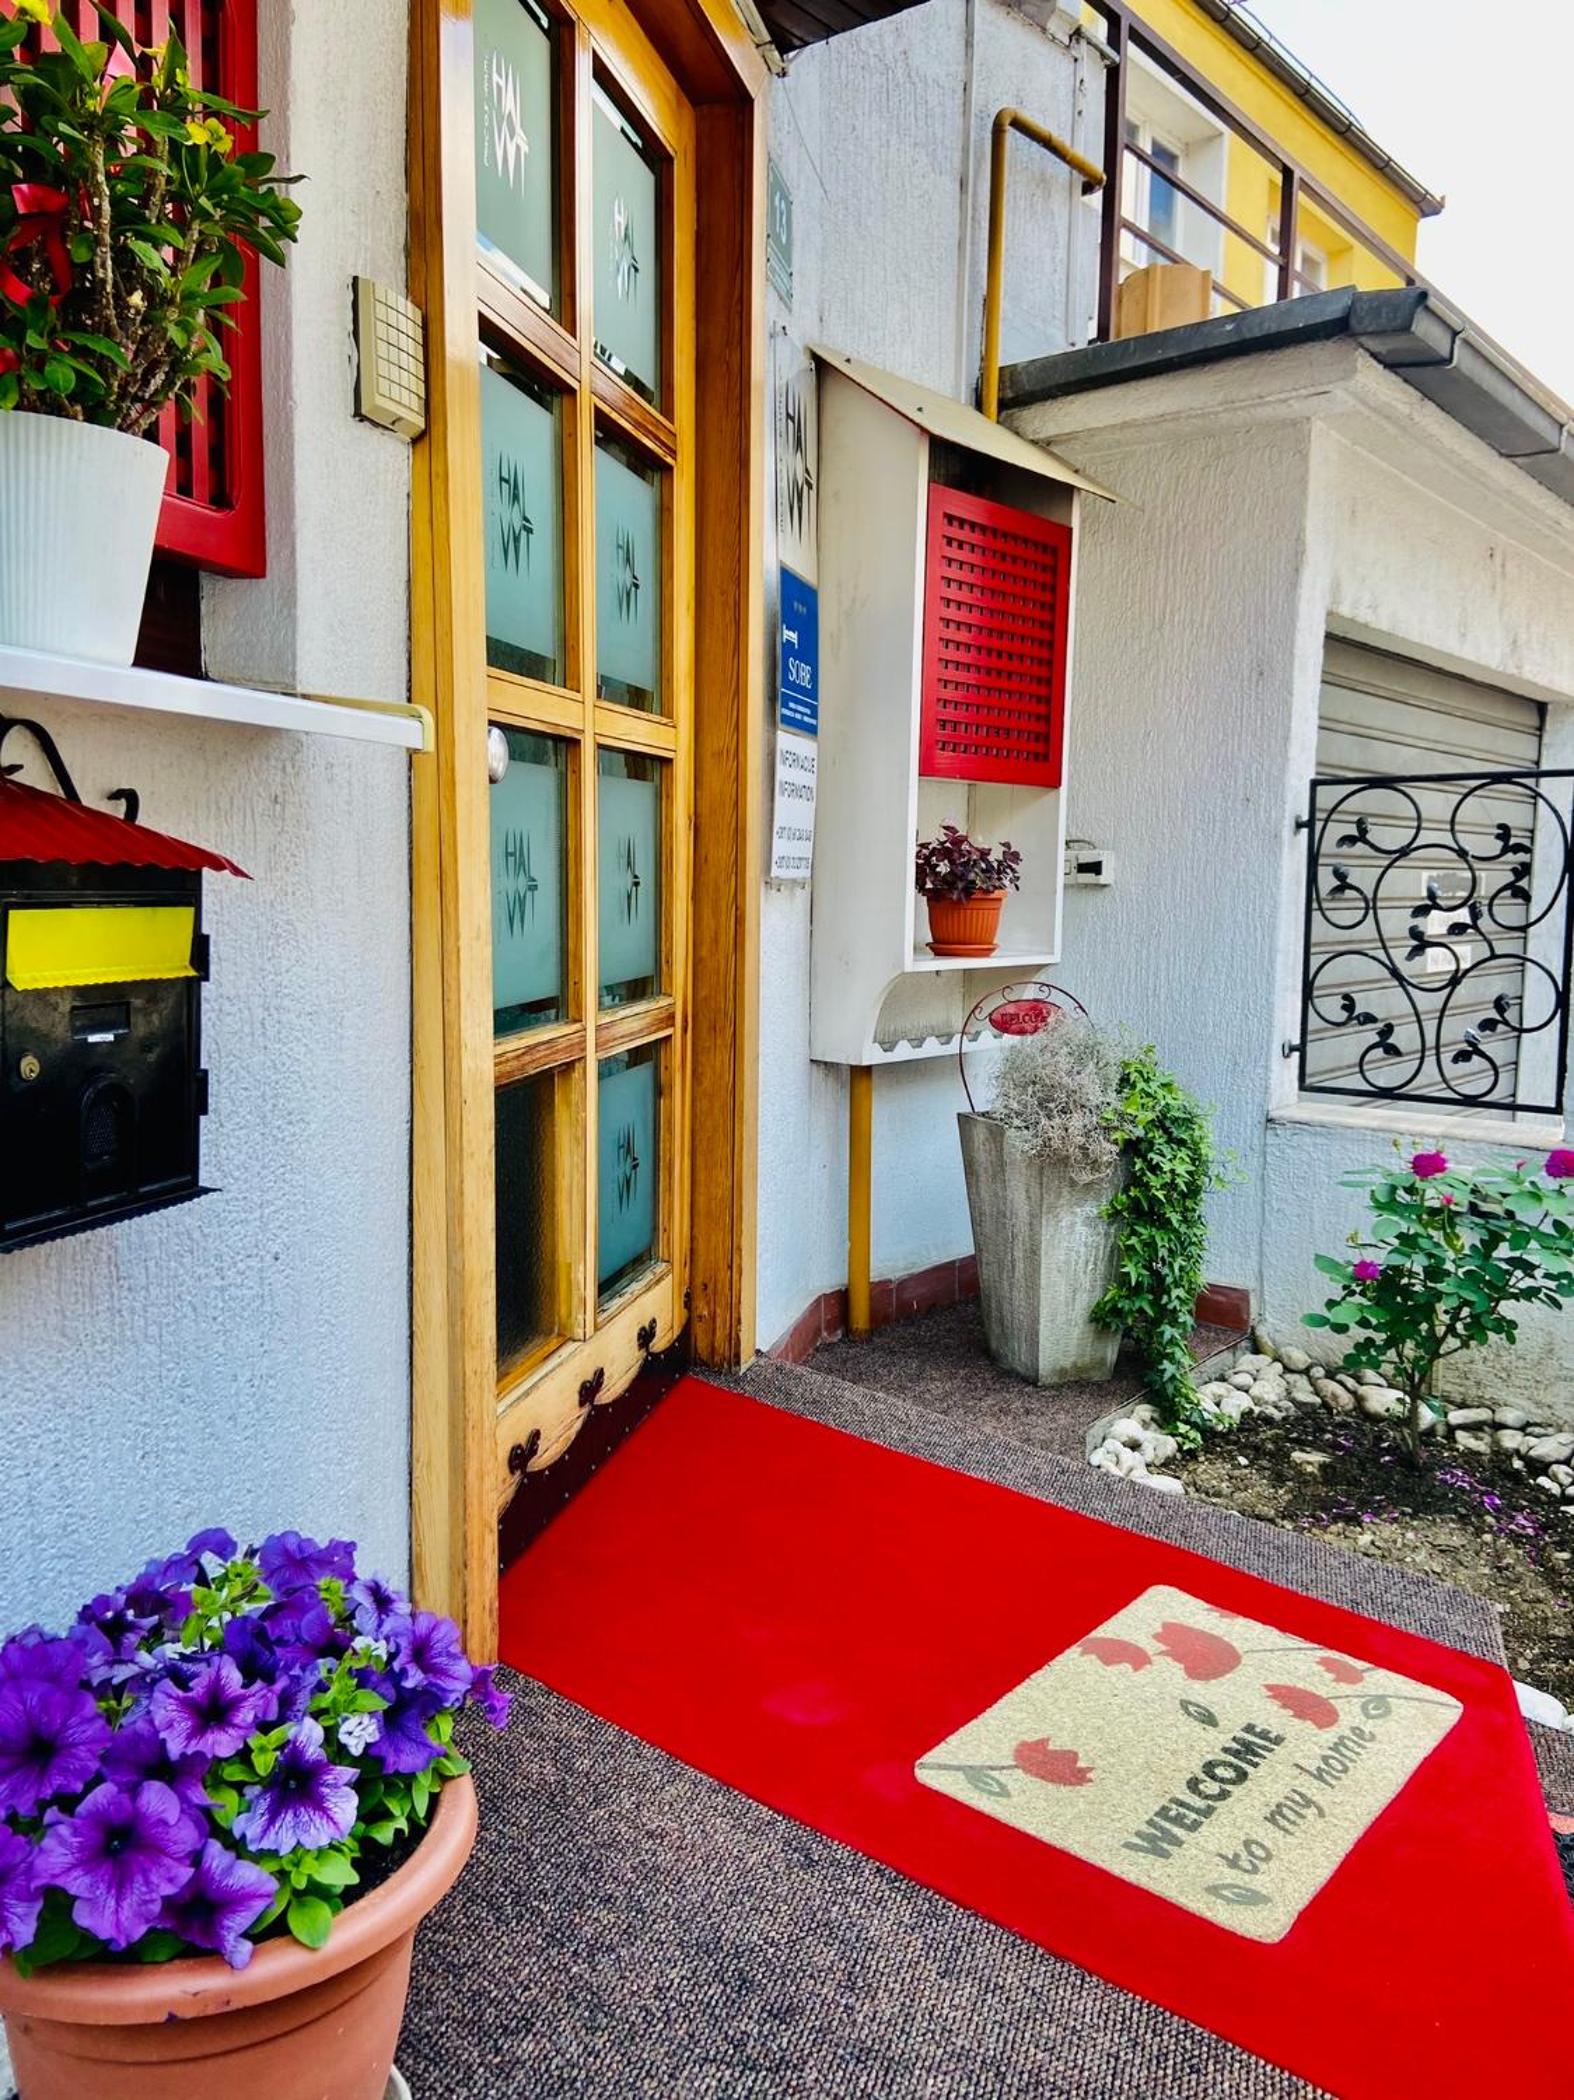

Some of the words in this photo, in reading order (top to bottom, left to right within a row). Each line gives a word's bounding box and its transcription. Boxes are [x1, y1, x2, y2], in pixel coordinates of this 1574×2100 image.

[775, 190, 787, 245] 13
[788, 657, 812, 689] SOBE
[1292, 1726, 1377, 1789] home
[1121, 1722, 1286, 1859] WELCOME
[1263, 1788, 1326, 1836] my
[1215, 1838, 1273, 1875] to
